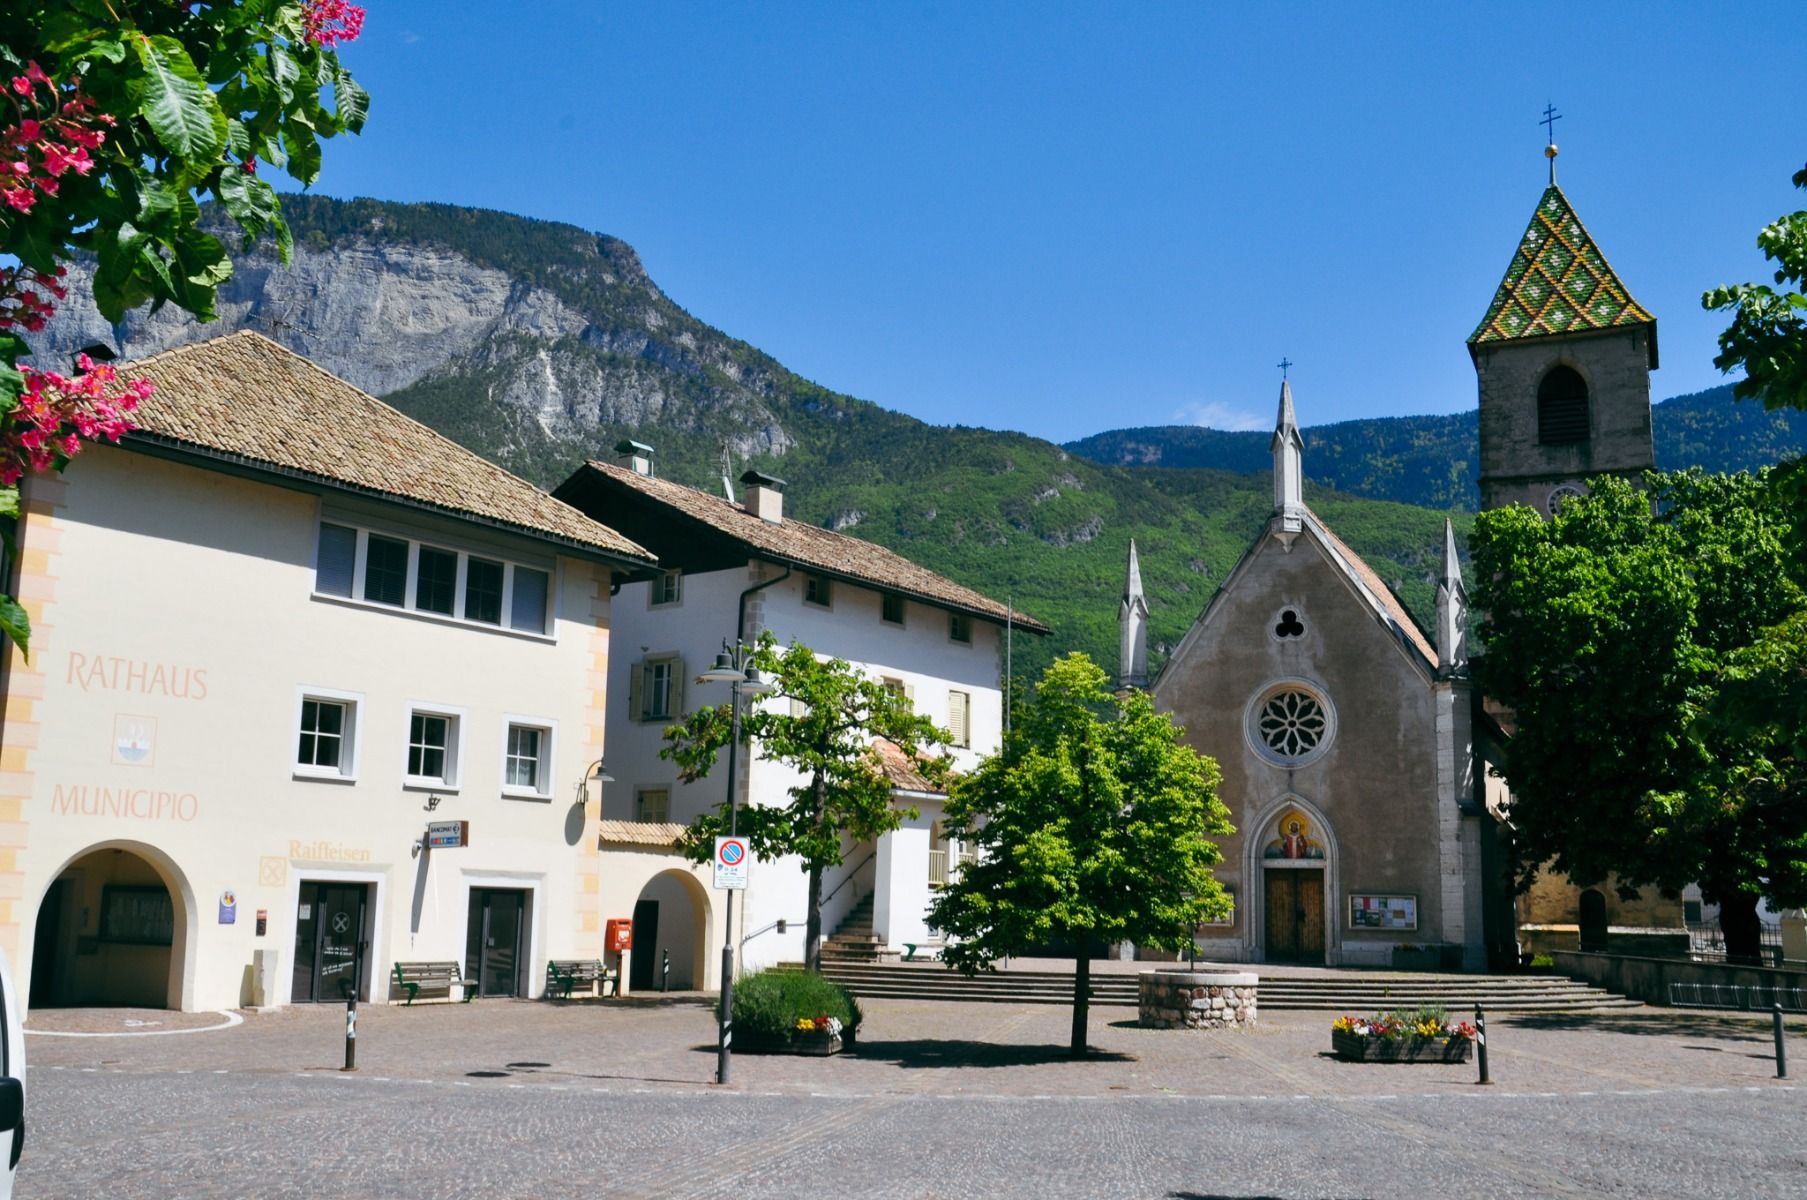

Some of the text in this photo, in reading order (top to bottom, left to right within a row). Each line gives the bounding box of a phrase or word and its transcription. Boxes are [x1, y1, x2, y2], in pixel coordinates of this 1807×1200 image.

[66, 651, 208, 700] RATHAUS
[51, 784, 199, 822] MUNICIPIO
[289, 839, 370, 861] Raiffeisen
